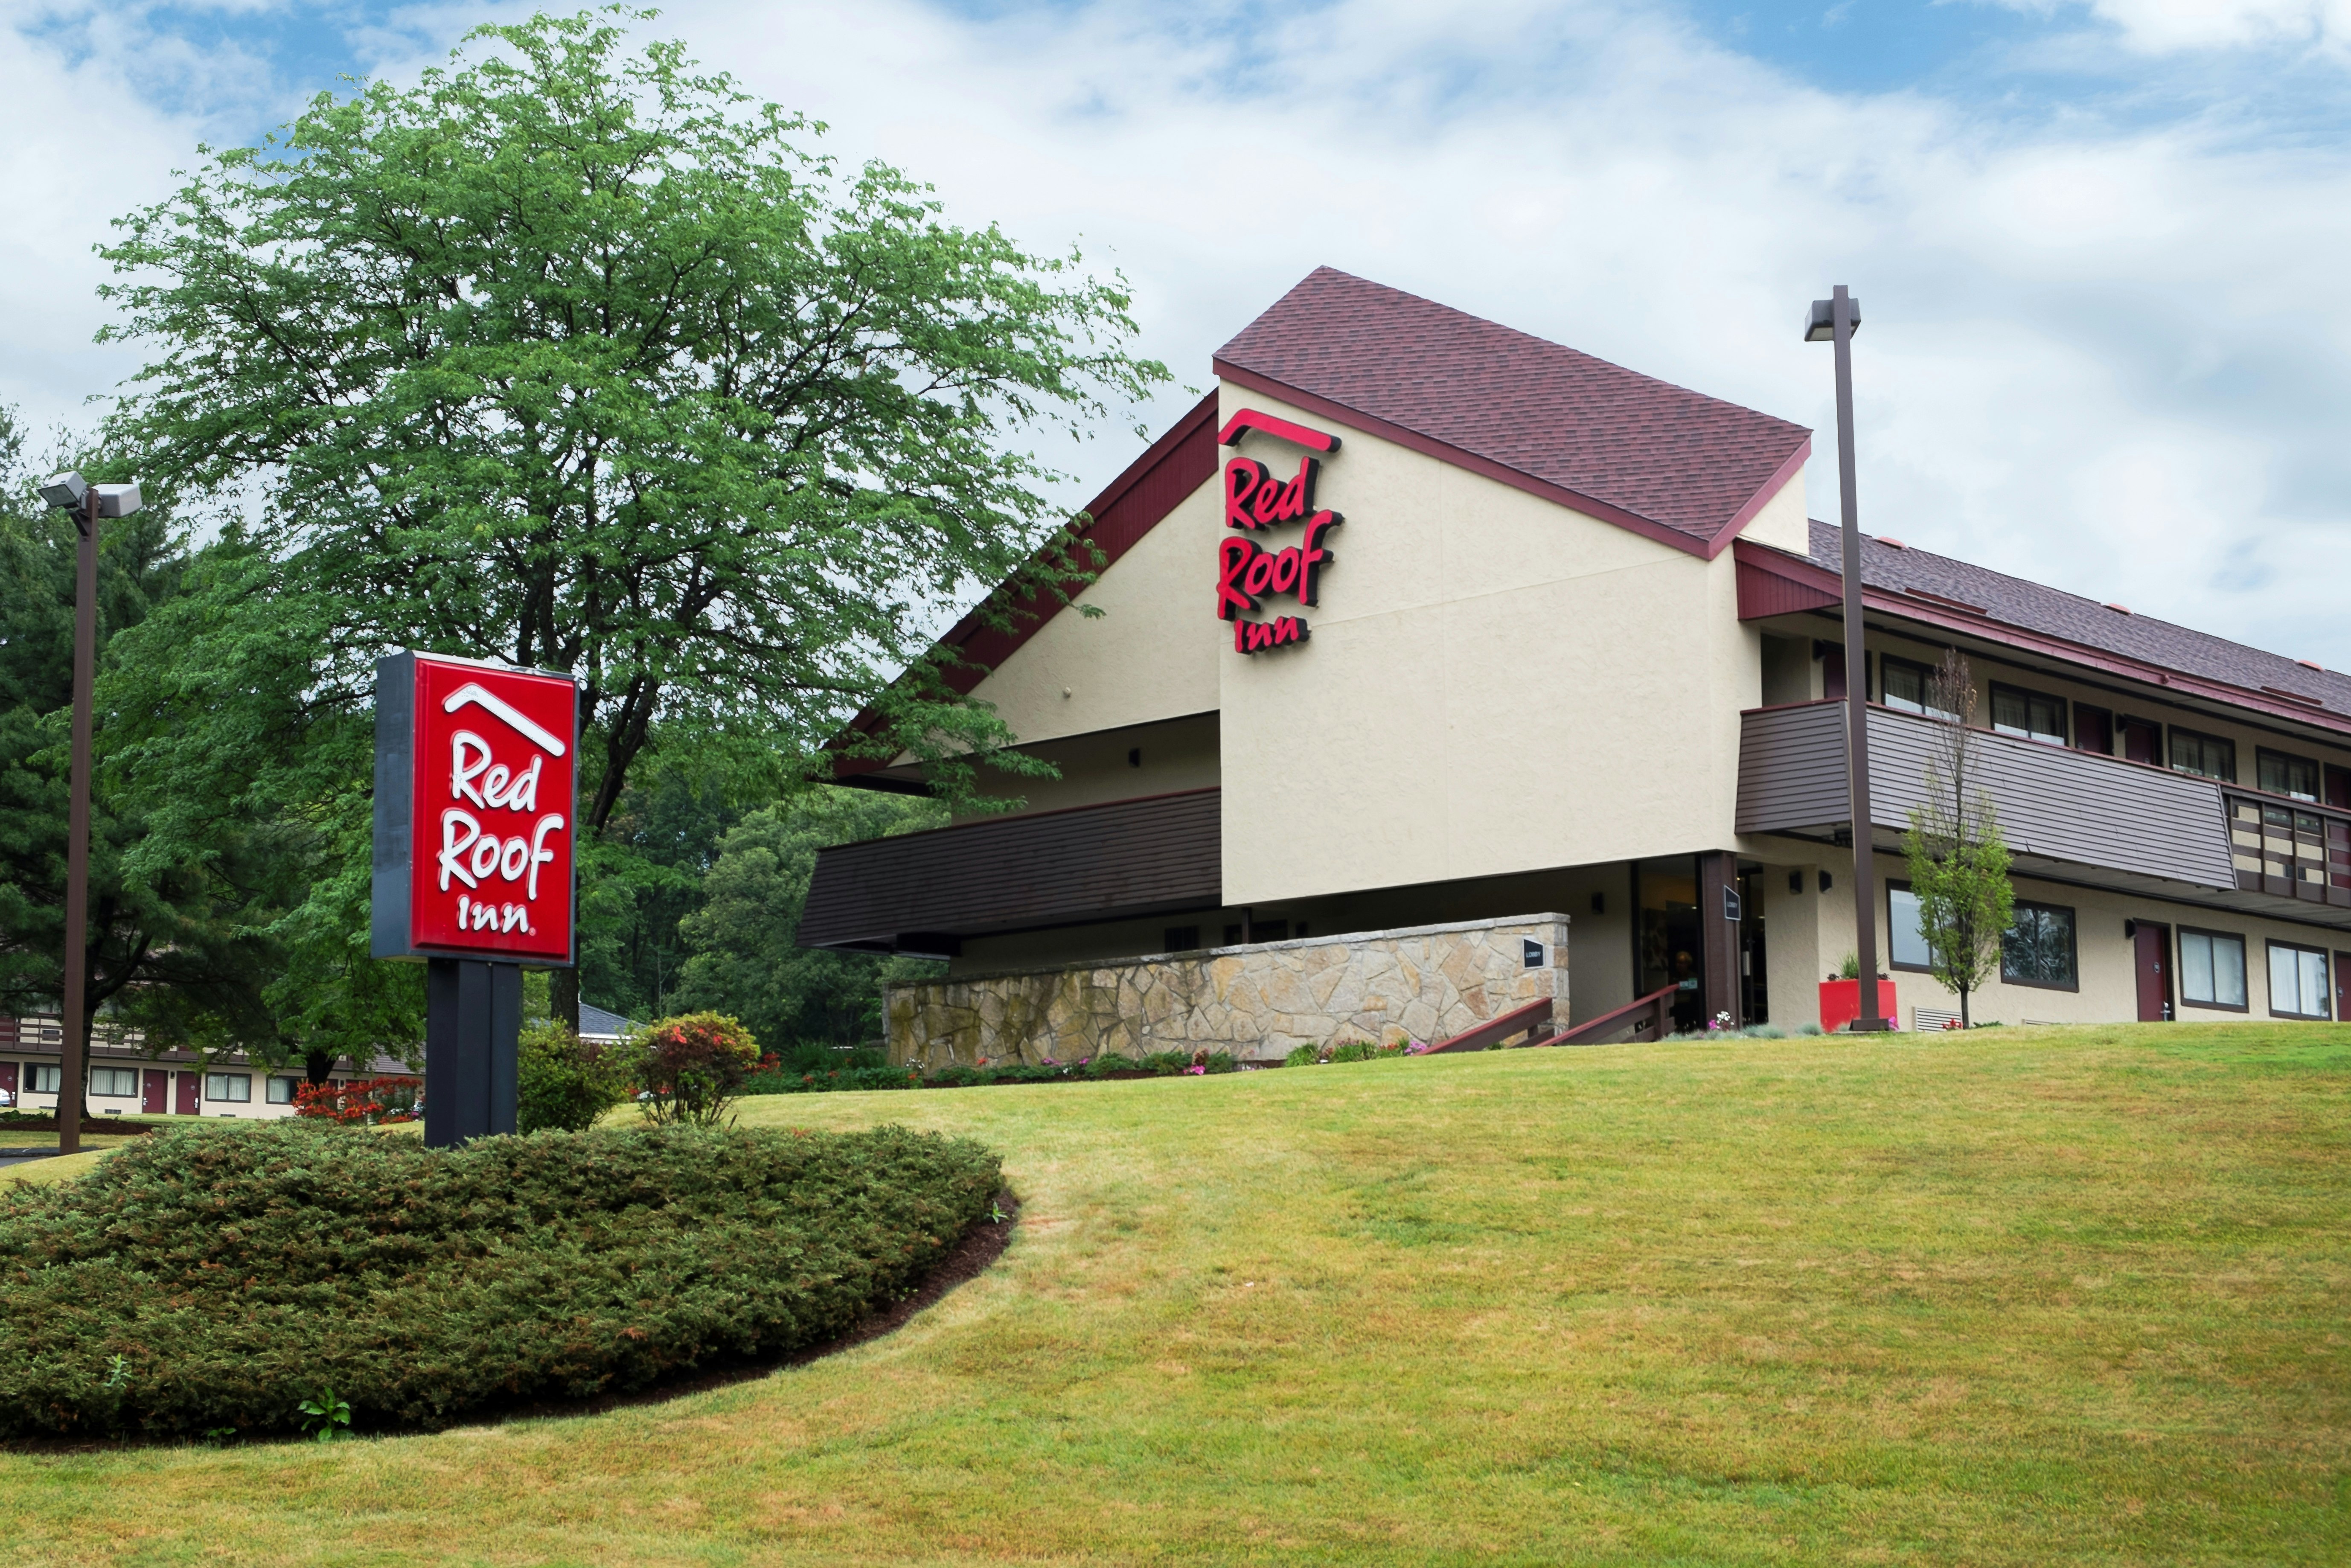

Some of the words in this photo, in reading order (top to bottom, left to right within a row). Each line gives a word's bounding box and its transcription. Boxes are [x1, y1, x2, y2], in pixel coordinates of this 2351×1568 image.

[1225, 456, 1311, 529] Red
[1216, 509, 1334, 620] Roof
[1234, 616, 1299, 653] Inn
[450, 730, 542, 812] Red
[437, 808, 564, 900] Roof
